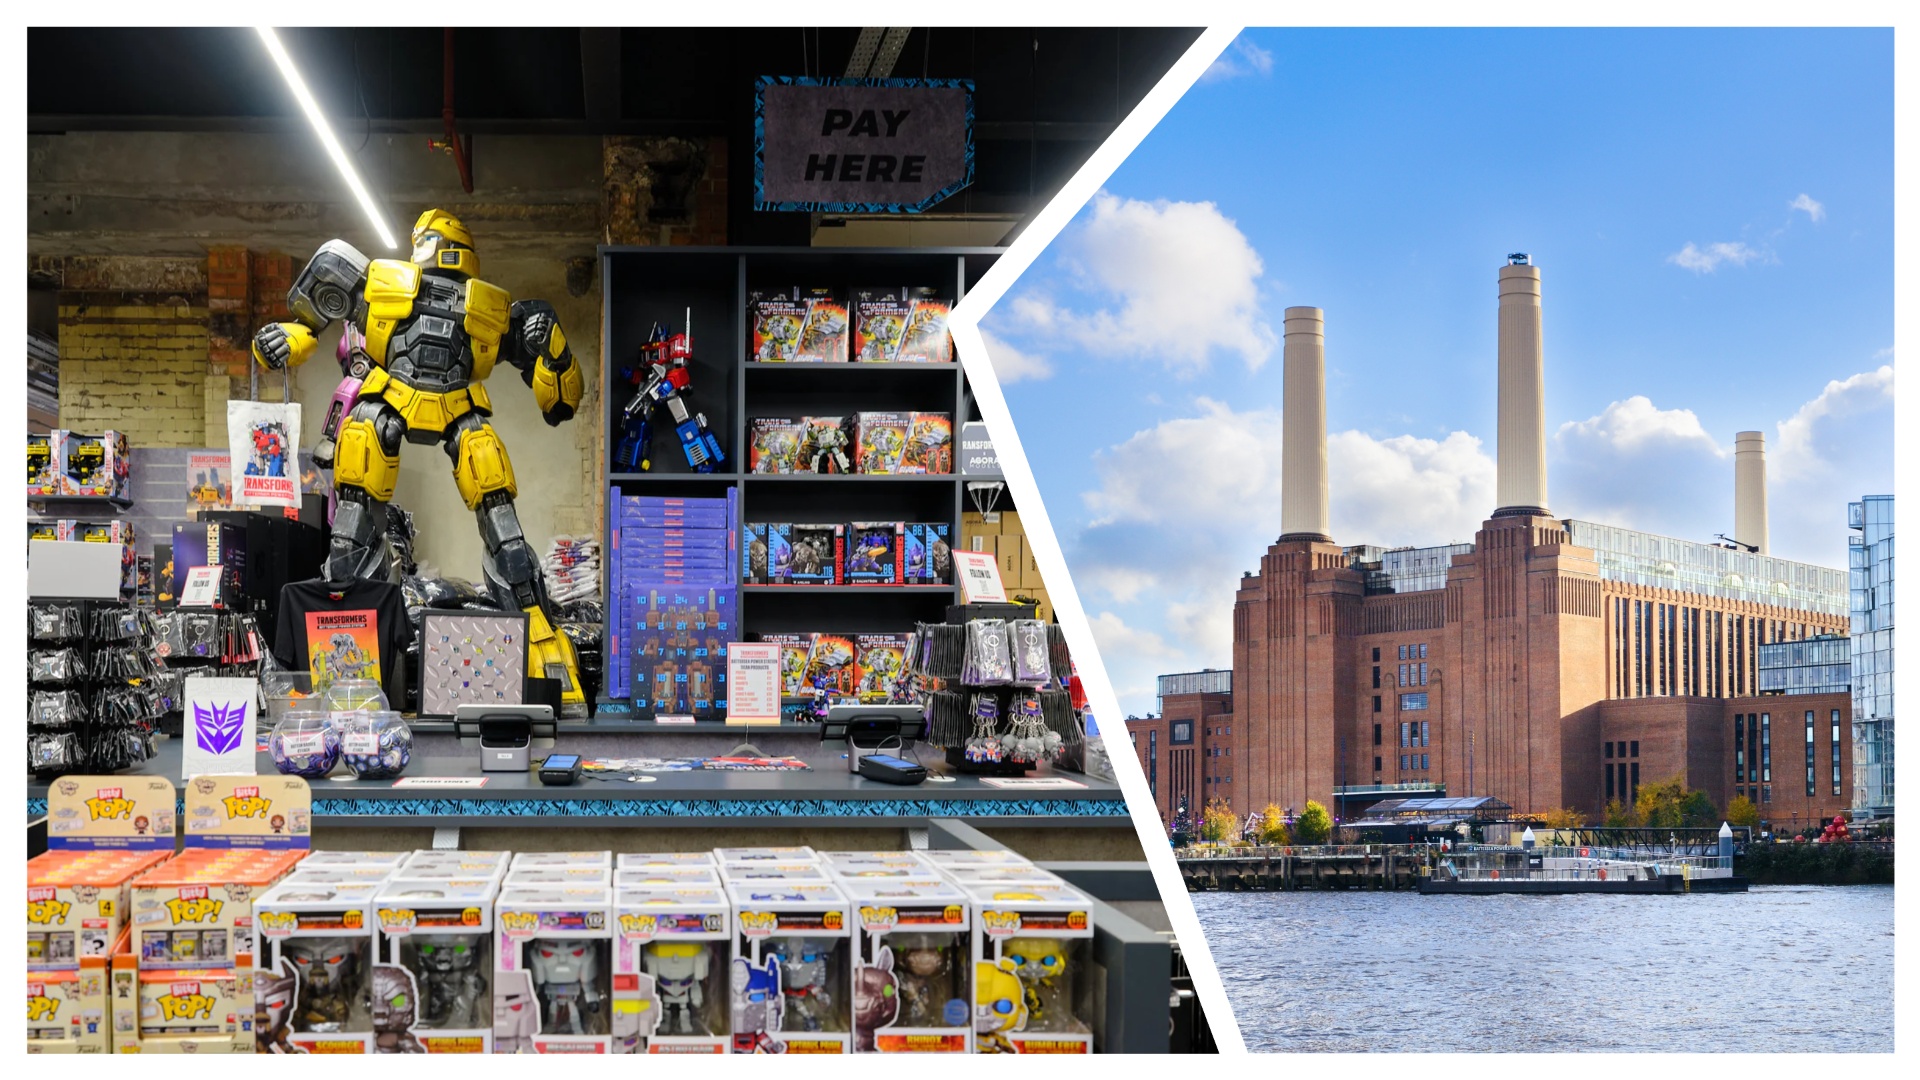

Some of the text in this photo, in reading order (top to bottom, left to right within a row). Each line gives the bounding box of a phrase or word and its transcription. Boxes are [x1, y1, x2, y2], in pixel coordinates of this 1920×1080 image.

[821, 109, 911, 137] PAY
[804, 154, 927, 183] HERE
[755, 525, 765, 535] 118
[938, 525, 948, 536] 118
[317, 615, 367, 624] TRANSFORMERS
[636, 699, 646, 707] 13
[716, 700, 727, 708] 25
[99, 789, 121, 800] Bitty
[236, 787, 257, 798] Bitty
[84, 797, 136, 821] POP!
[221, 795, 272, 819] POP!
[180, 887, 206, 900] Bitty
[104, 902, 111, 911] 4
[164, 898, 224, 925] POP!
[259, 912, 297, 930] POP!
[377, 909, 416, 926] POP!
[501, 912, 538, 930] POP!
[618, 915, 656, 932] POP!
[739, 912, 776, 929] POP!
[859, 907, 896, 924] POP!
[982, 912, 1020, 929] POP!
[172, 983, 198, 996] Bitty
[156, 994, 216, 1022] POP!
[906, 1036, 942, 1044] RHINOX
[1024, 1041, 1081, 1049] BUMBLEBEE
